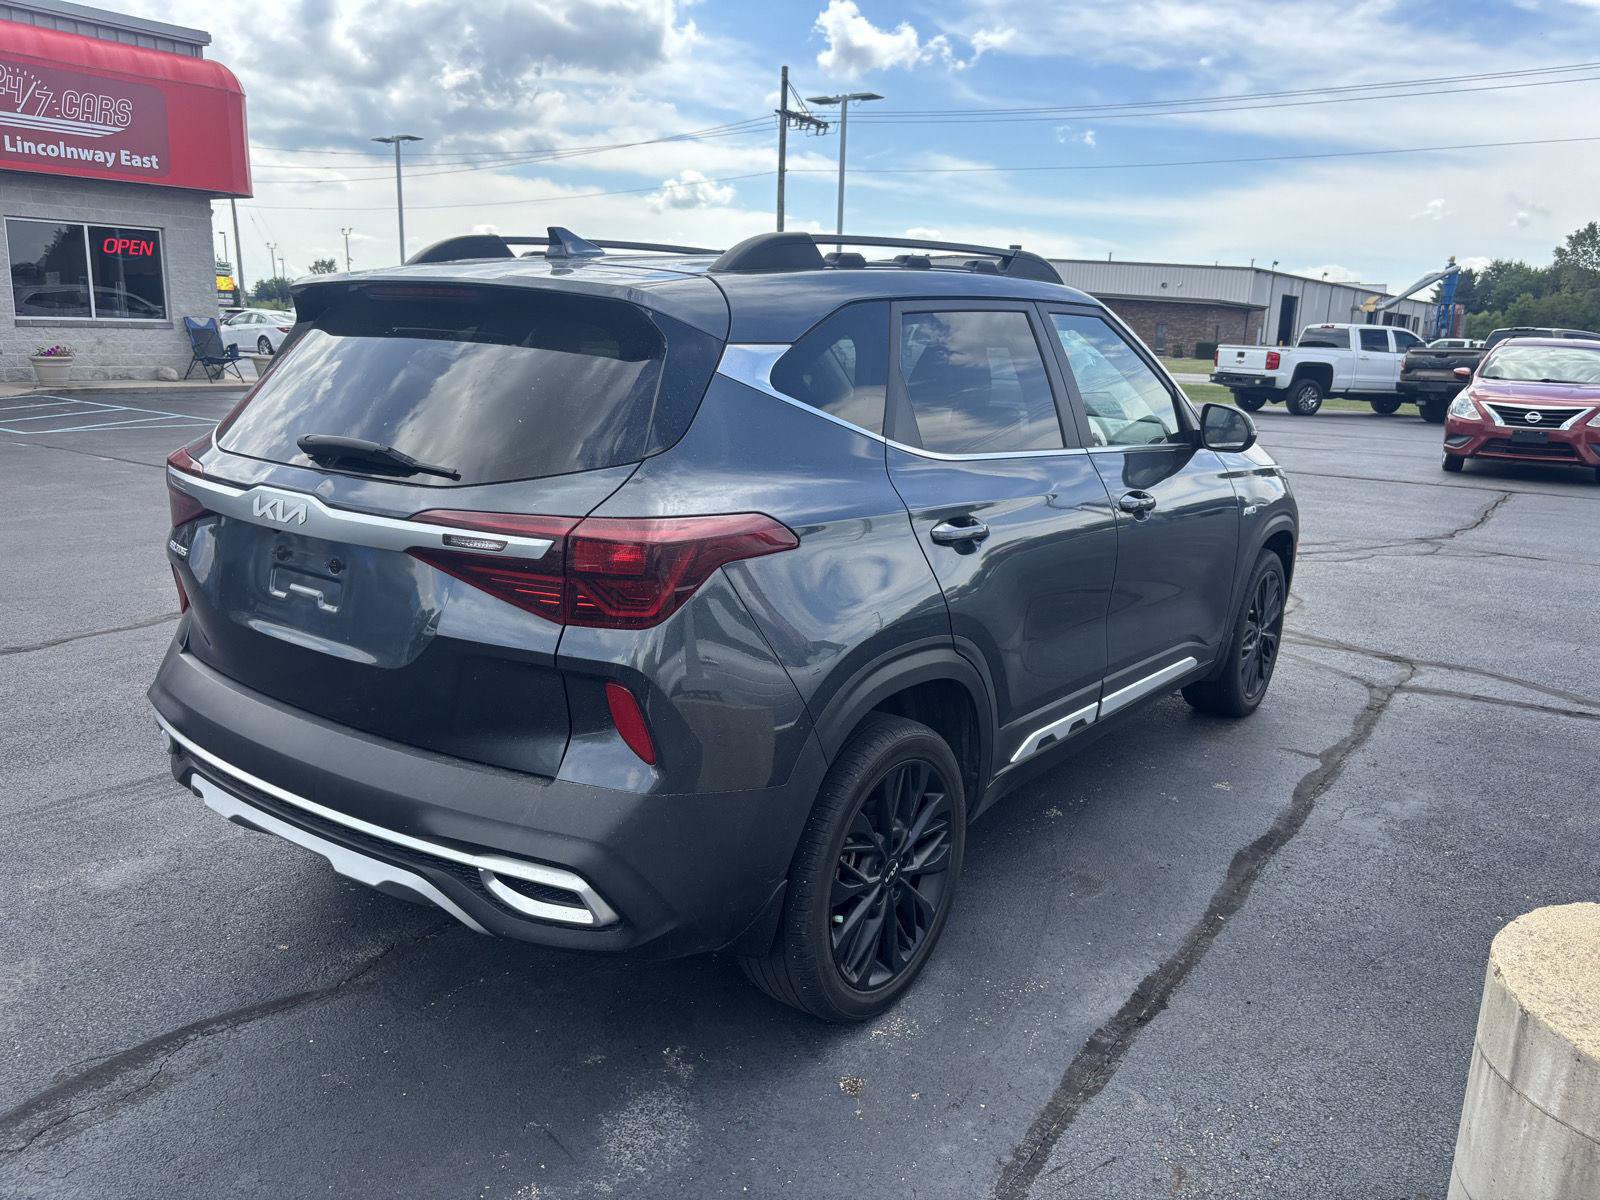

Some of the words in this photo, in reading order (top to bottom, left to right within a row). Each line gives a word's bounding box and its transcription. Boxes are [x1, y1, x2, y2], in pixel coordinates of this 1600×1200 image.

[61, 90, 133, 127] CARS
[4, 135, 116, 168] Lincolnway
[120, 150, 159, 170] East
[103, 238, 154, 257] OPEN
[253, 495, 307, 525] KIA
